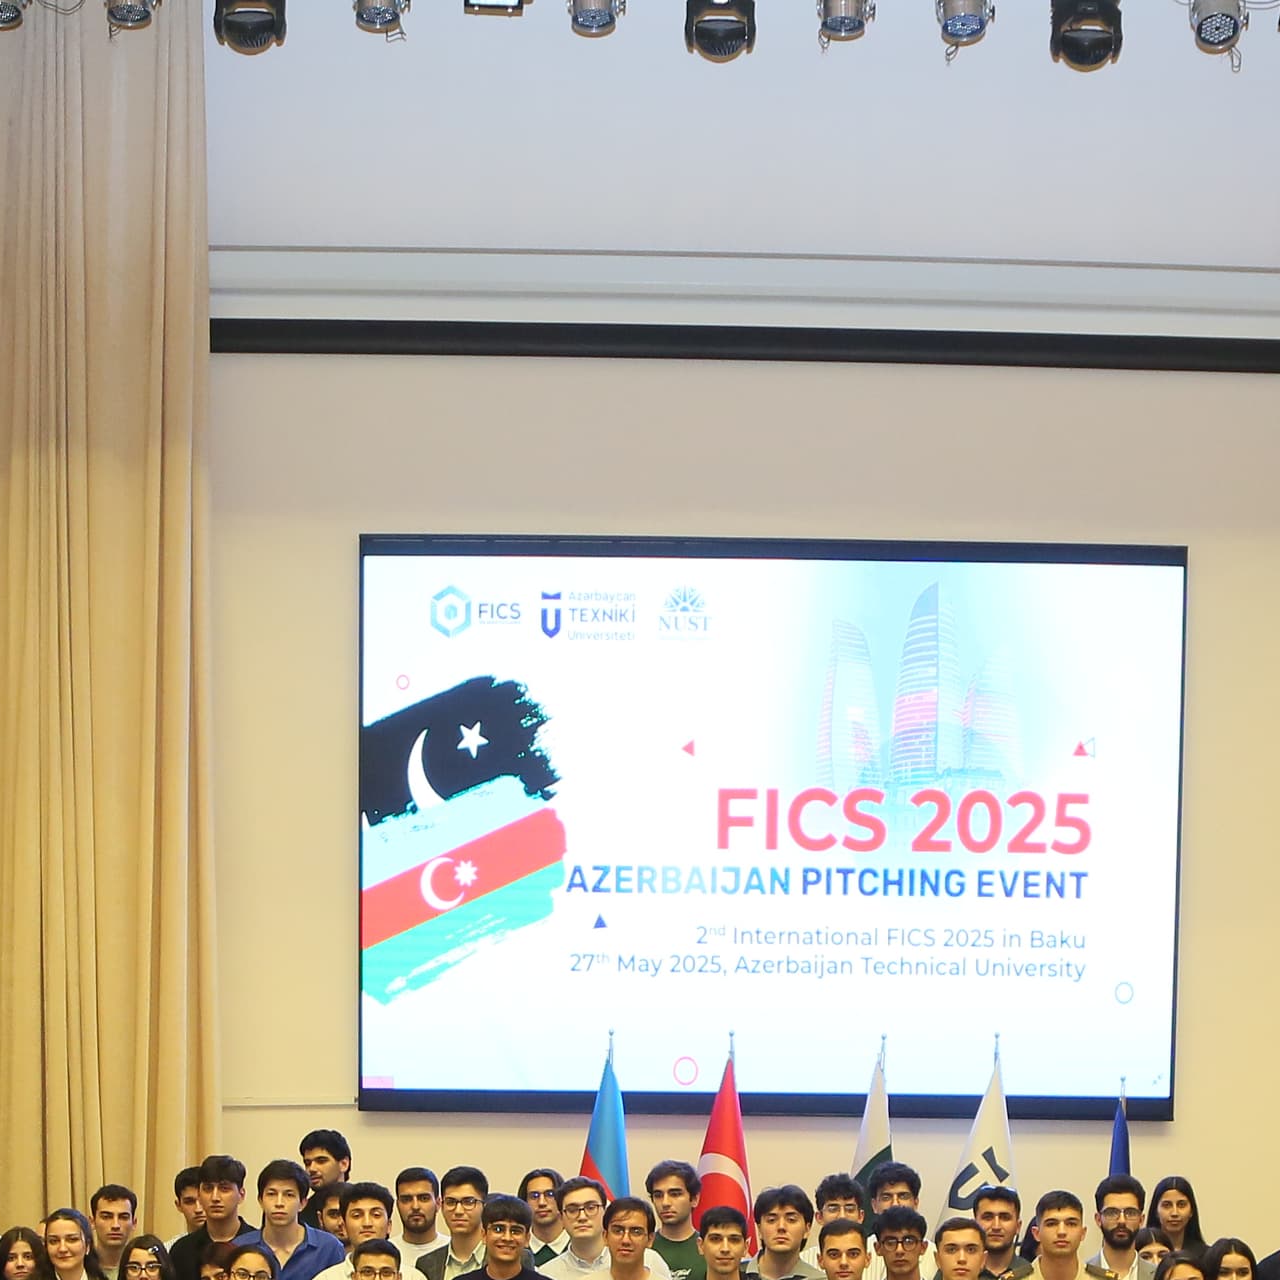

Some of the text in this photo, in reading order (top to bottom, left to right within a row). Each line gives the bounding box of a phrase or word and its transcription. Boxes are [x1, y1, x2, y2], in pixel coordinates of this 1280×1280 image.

[478, 603, 521, 620] FICS
[568, 603, 636, 623] TEXNİKİ
[658, 615, 713, 632] NUST
[717, 787, 1092, 855] FICS 2025
[566, 865, 1089, 899] AZERBAIJAN PITCHING EVENT
[733, 925, 878, 946] International
[888, 928, 936, 947] FICS
[943, 929, 995, 948] 2025
[1002, 928, 1022, 948] in
[1030, 929, 1086, 949] Baku
[618, 954, 663, 977] May
[669, 955, 728, 976] 2025,
[734, 954, 853, 979] Azerbaijan
[860, 956, 966, 977] Technical
[975, 958, 1087, 983] University
